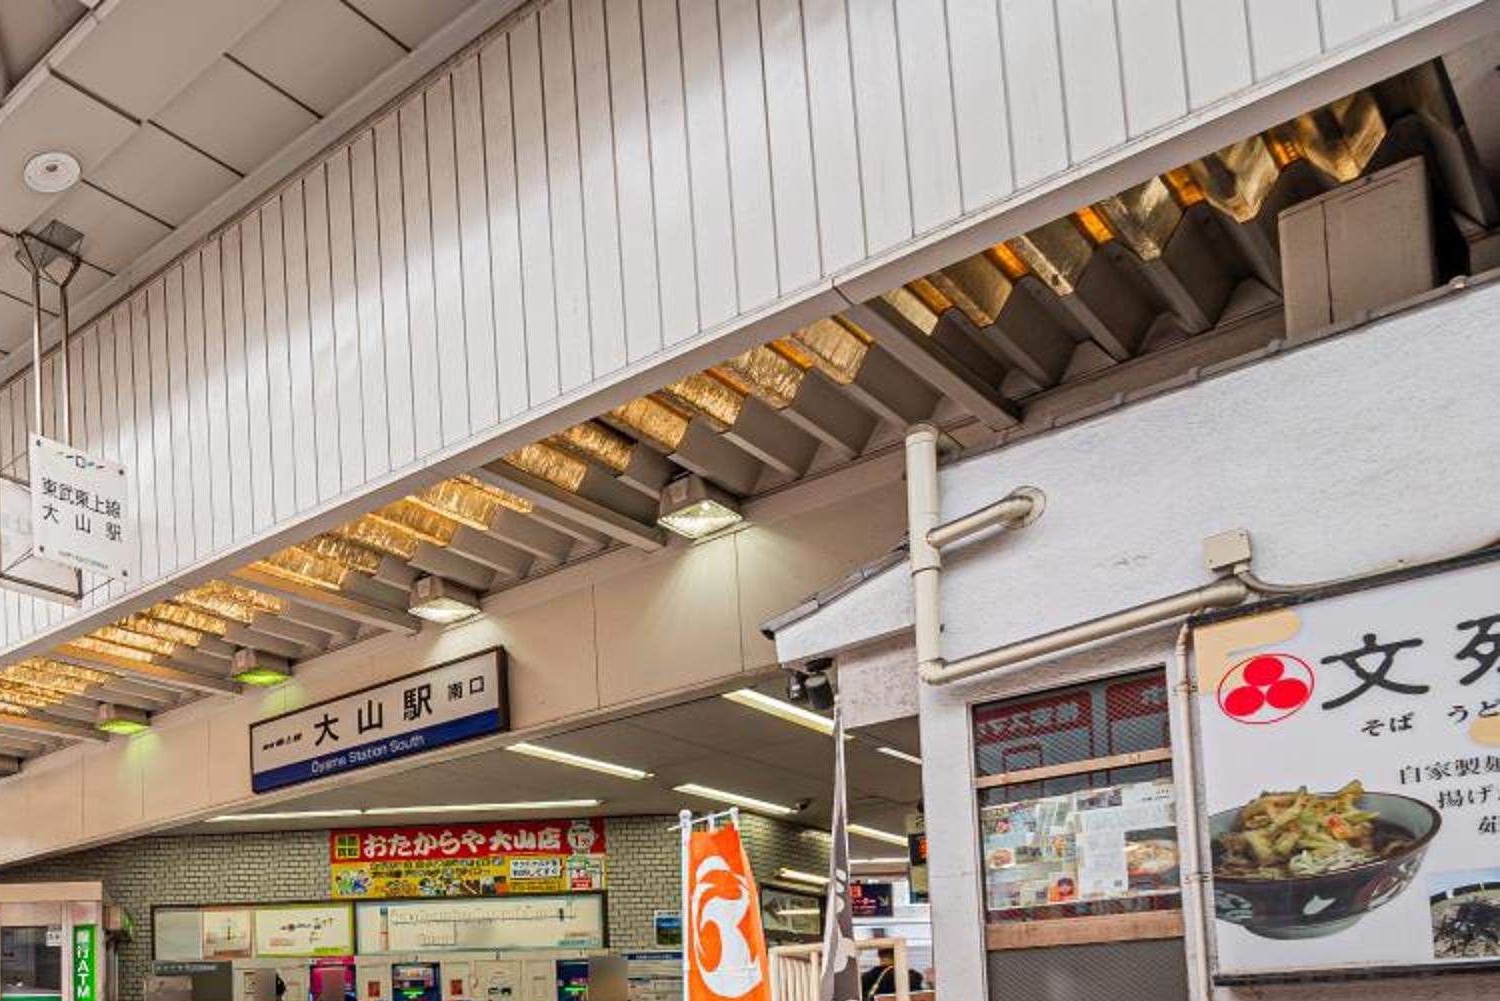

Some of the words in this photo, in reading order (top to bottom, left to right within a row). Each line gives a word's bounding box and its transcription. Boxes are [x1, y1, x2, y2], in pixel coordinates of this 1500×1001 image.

[42, 477, 121, 519] 東武東上線
[42, 503, 122, 543] 大山駅
[314, 683, 432, 746] 大山駅
[447, 675, 485, 702] 南口
[1361, 711, 1414, 736] そば
[349, 746, 387, 764] Station
[389, 736, 426, 755] South
